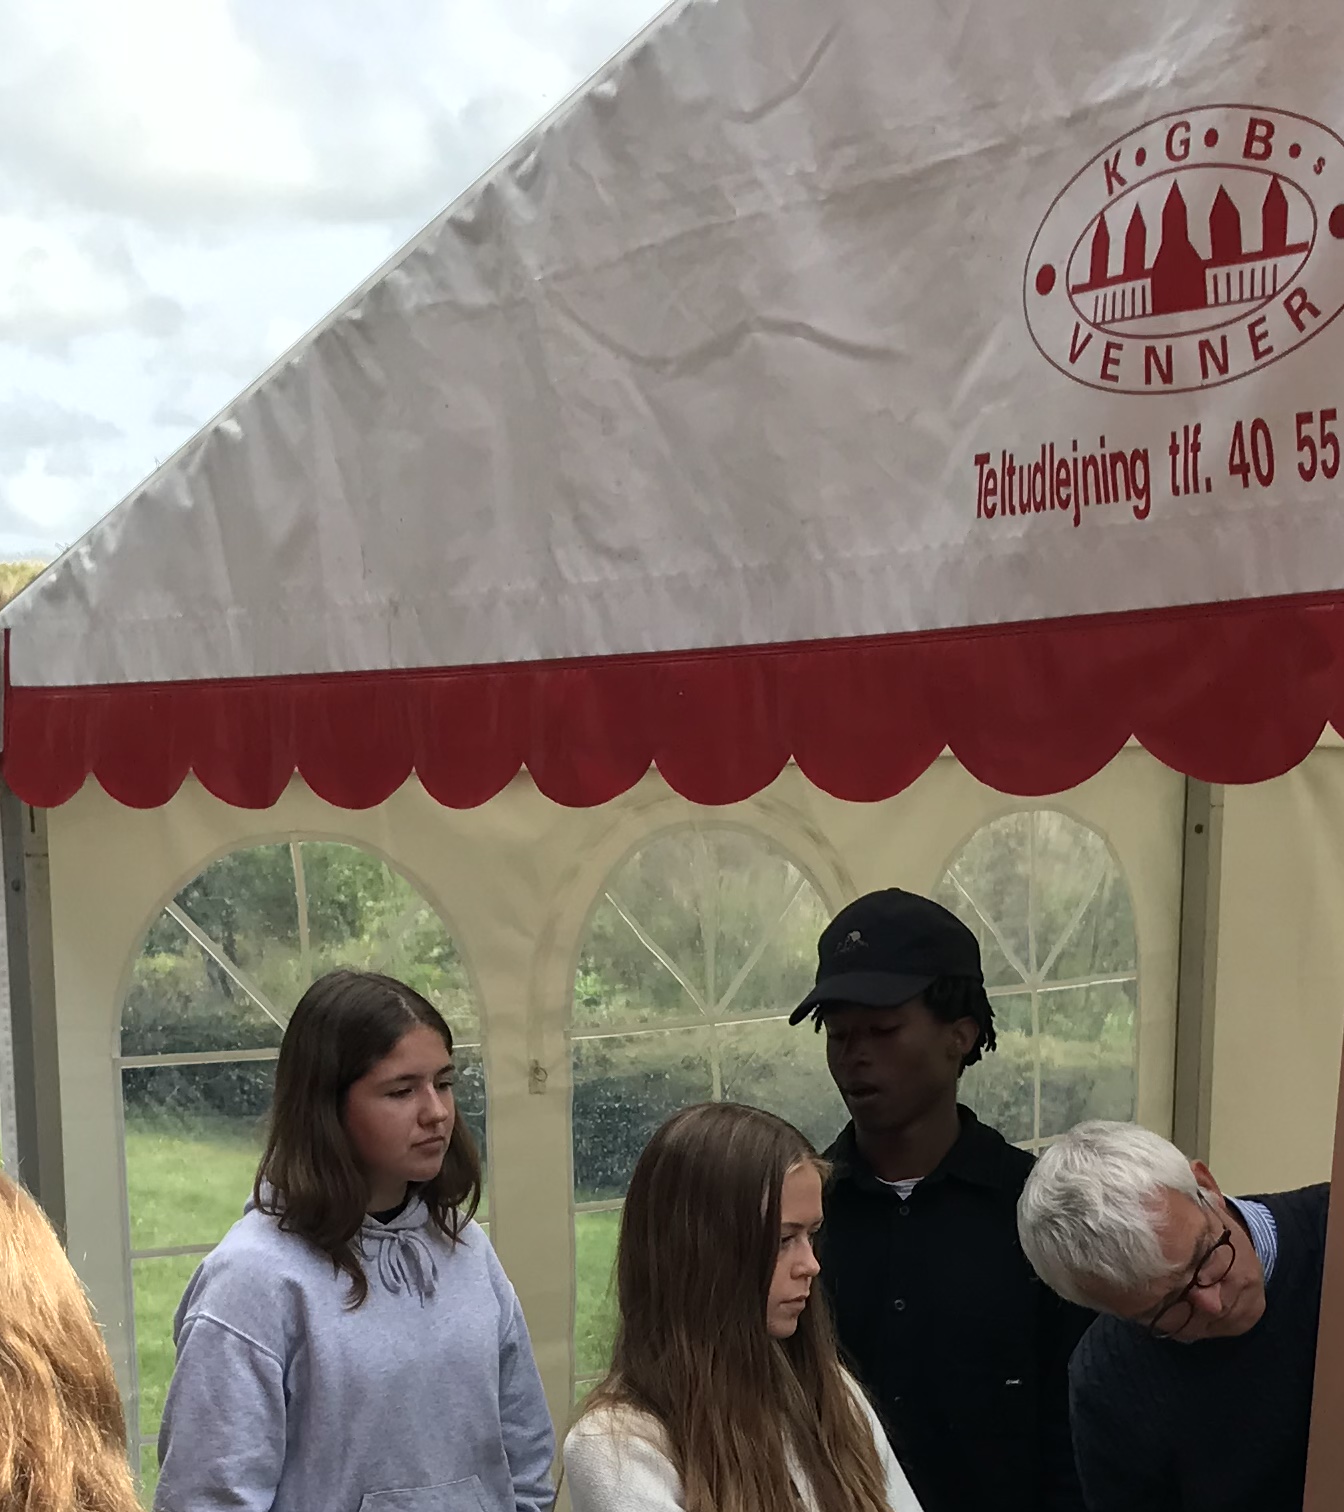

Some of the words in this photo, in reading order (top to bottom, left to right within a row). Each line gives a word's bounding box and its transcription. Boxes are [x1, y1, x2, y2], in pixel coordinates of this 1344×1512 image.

[1067, 286, 1321, 386] VENNER
[973, 436, 1151, 528] Teltudlejning
[1167, 422, 1213, 497] tlf.
[1227, 417, 1275, 490] 40
[1294, 407, 1341, 482] 55
